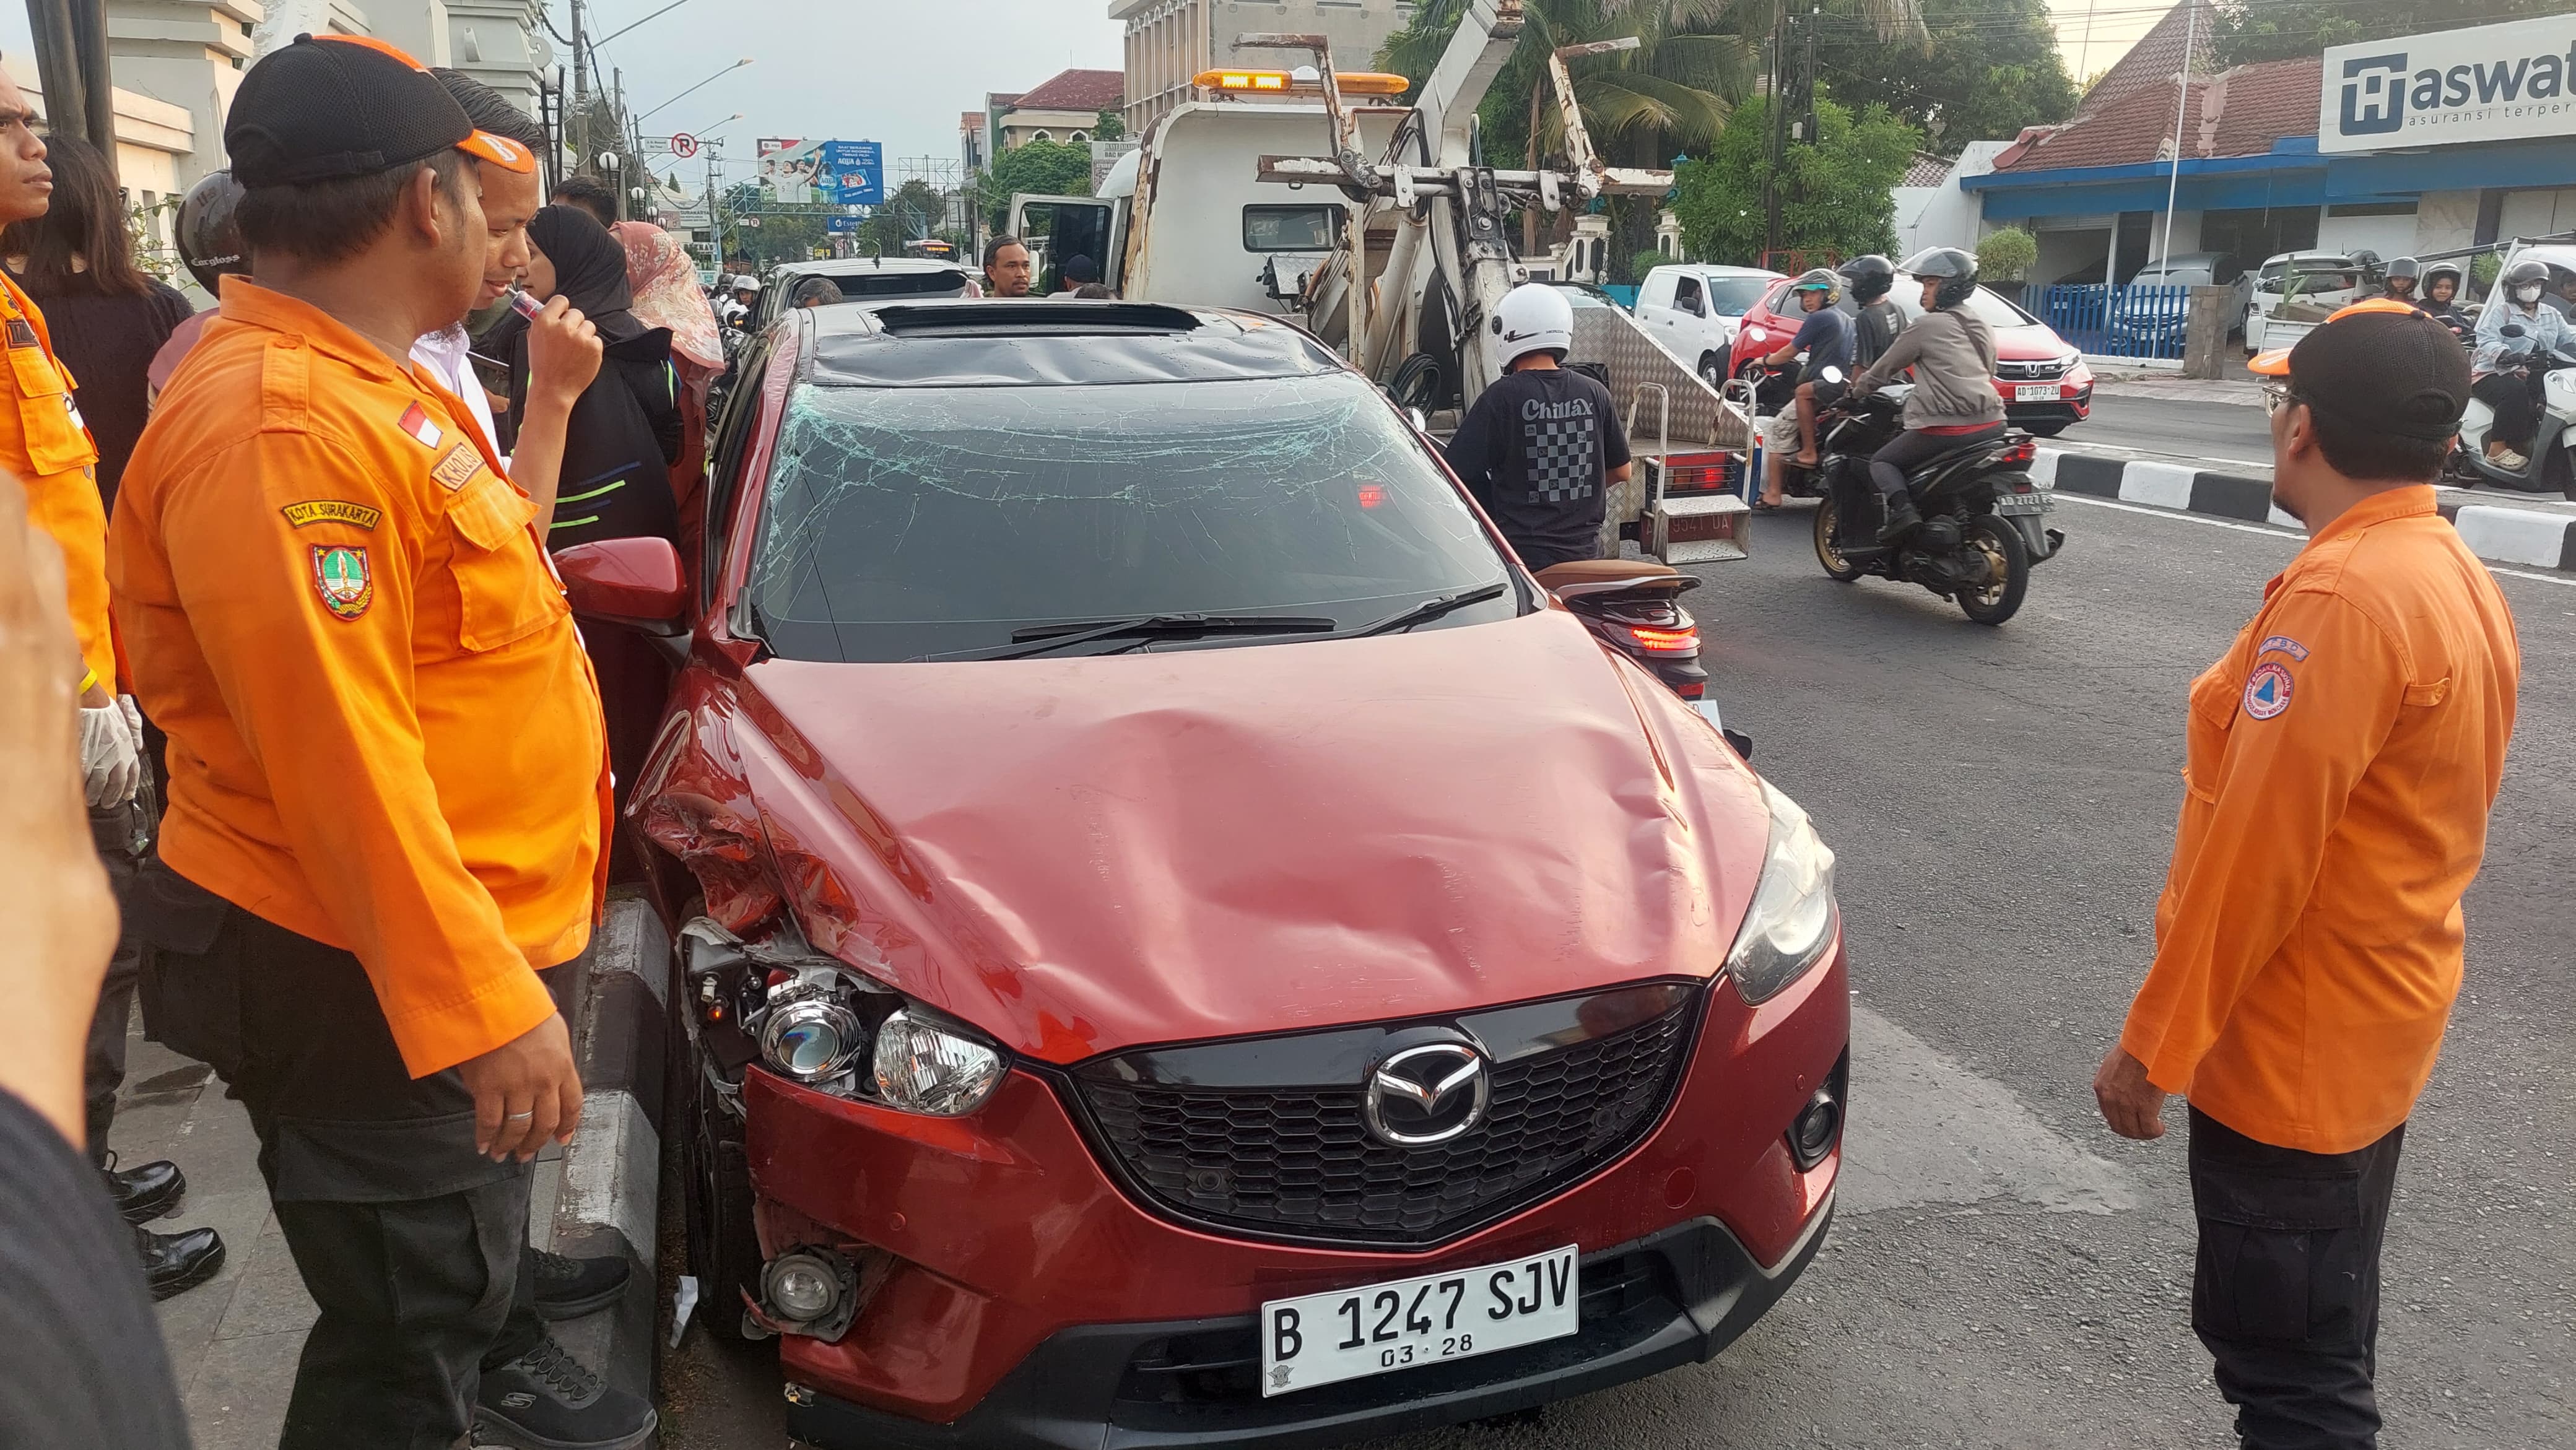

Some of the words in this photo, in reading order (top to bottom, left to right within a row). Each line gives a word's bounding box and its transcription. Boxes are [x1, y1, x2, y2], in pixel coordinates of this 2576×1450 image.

[2411, 39, 2576, 111] aswat
[2409, 107, 2492, 127] asuransi
[2505, 103, 2570, 120] terper
[837, 157, 855, 165] AQUA
[191, 253, 241, 267] Cargloss
[2017, 386, 2026, 396] AD
[2029, 386, 2047, 396] 1073
[2051, 386, 2060, 394] ZU
[1521, 397, 1593, 421] Chillax
[437, 448, 479, 485] KHOLIS
[288, 505, 316, 521] KOTA
[318, 503, 374, 525] SURAKARTA
[1672, 516, 1704, 533] 9541
[2252, 664, 2271, 682] BADAN
[2272, 664, 2291, 692] NASIONAL
[2268, 698, 2287, 716] BENCANA
[1274, 1308, 1302, 1363] B
[1338, 1279, 1466, 1350] 1247
[1487, 1254, 1572, 1321] SJV
